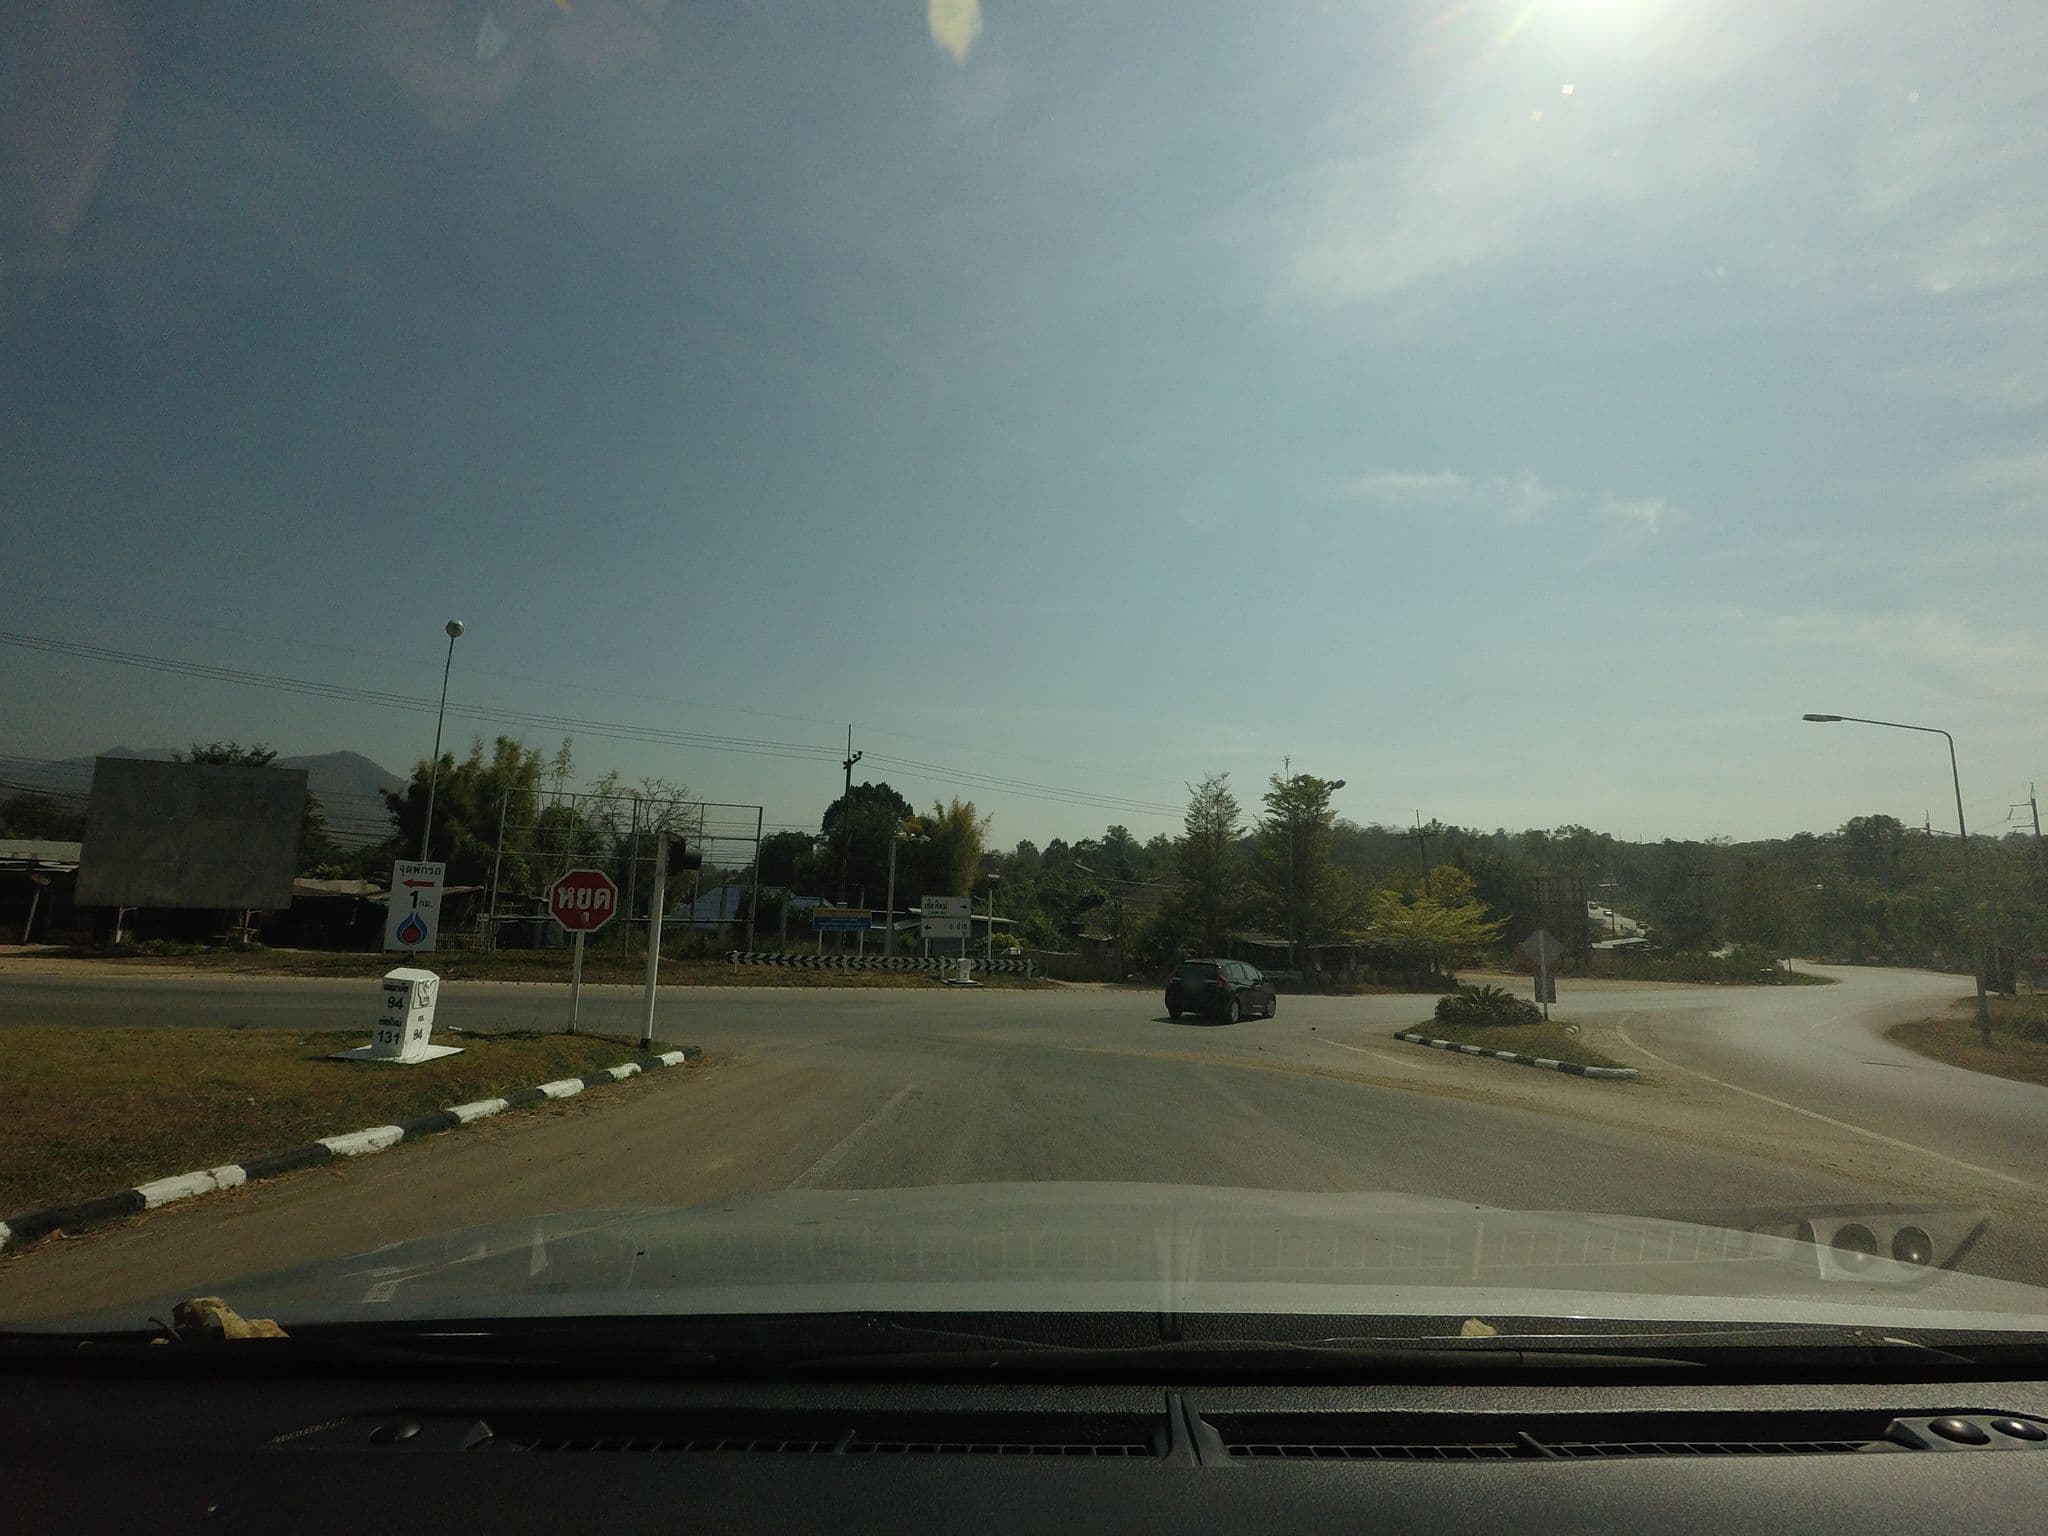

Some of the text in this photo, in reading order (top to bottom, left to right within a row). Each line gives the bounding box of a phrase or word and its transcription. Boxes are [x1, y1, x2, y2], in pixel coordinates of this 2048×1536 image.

[399, 863, 442, 876] จุดพักรถ
[409, 890, 419, 909] 1
[557, 887, 611, 922] หยุด
[387, 996, 404, 1010] 94
[377, 1029, 401, 1045] 131
